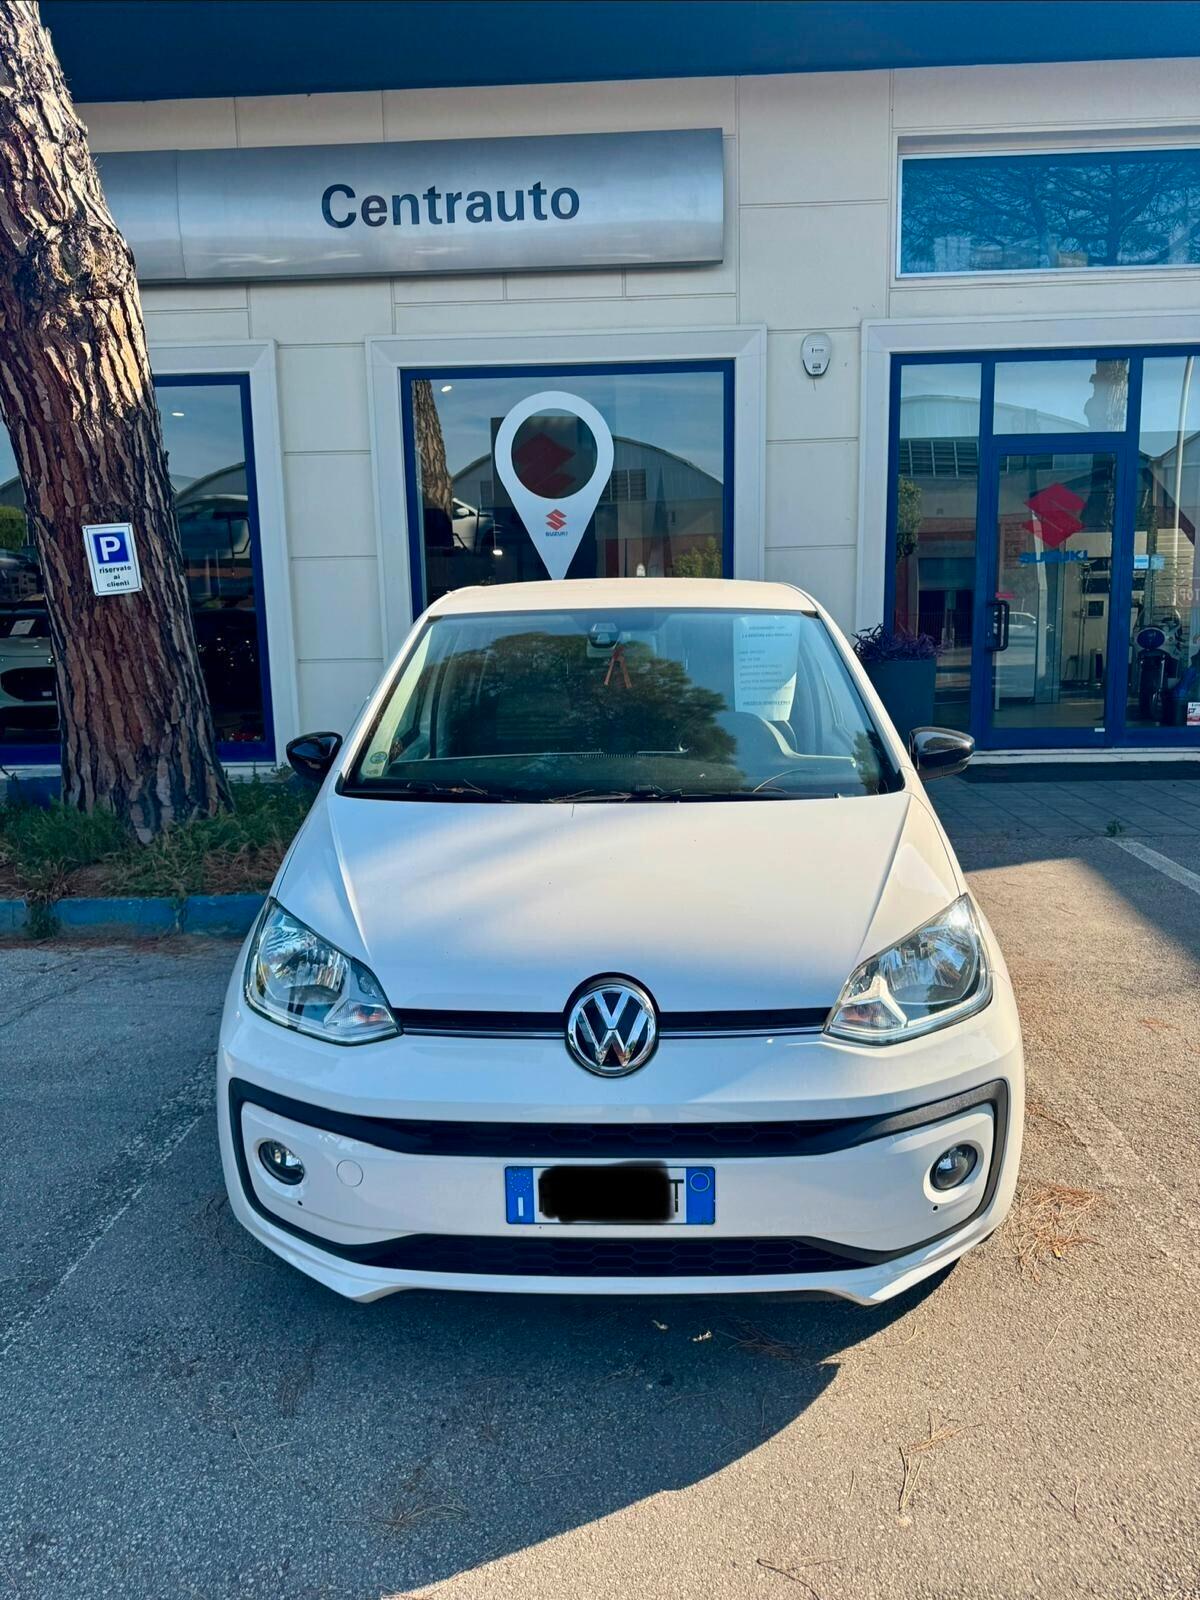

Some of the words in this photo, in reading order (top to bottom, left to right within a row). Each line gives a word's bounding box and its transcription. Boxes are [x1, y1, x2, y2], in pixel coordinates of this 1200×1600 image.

[321, 181, 580, 229] Centrauto
[99, 536, 121, 561] P
[99, 565, 132, 574] riservato
[106, 580, 130, 588] clienti
[573, 988, 653, 1072] VW
